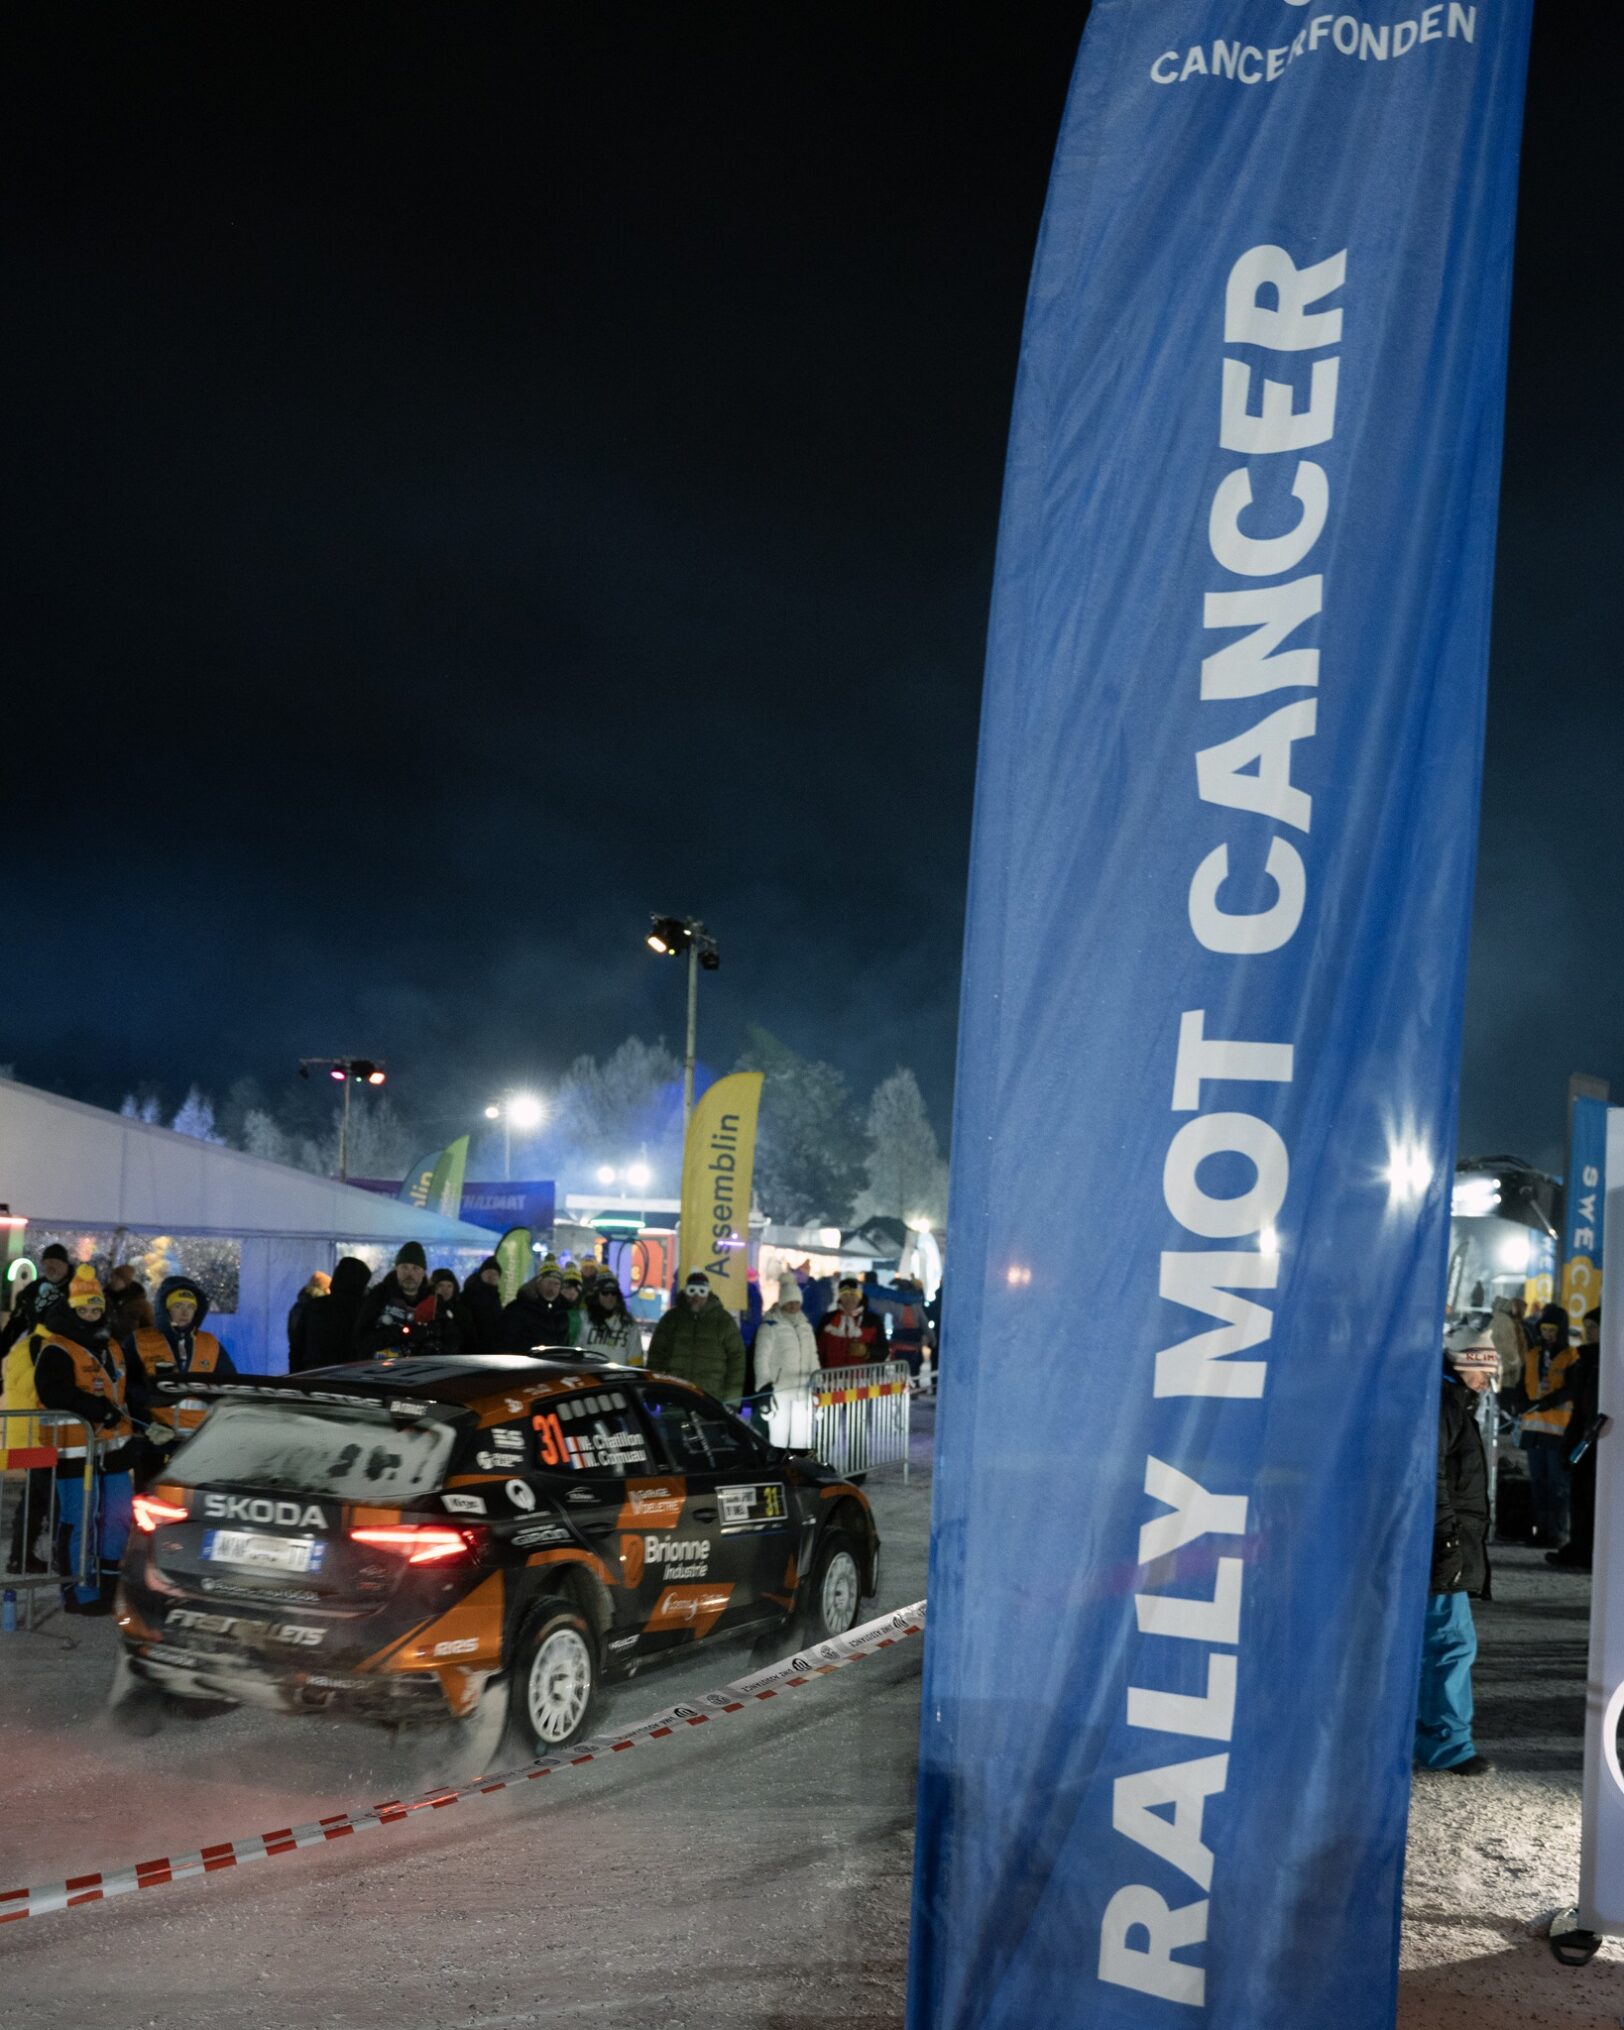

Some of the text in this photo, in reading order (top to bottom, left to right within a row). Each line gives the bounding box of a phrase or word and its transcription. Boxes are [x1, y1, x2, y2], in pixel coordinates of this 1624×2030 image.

[1150, 2, 1476, 84] CANCERFONDEN
[1098, 245, 1347, 2008] RALLY MOT CANCER
[704, 1113, 740, 1279] Assemblin
[532, 1413, 570, 1466] 31
[205, 1494, 328, 1529] SKODA
[644, 1535, 711, 1564] Brionne
